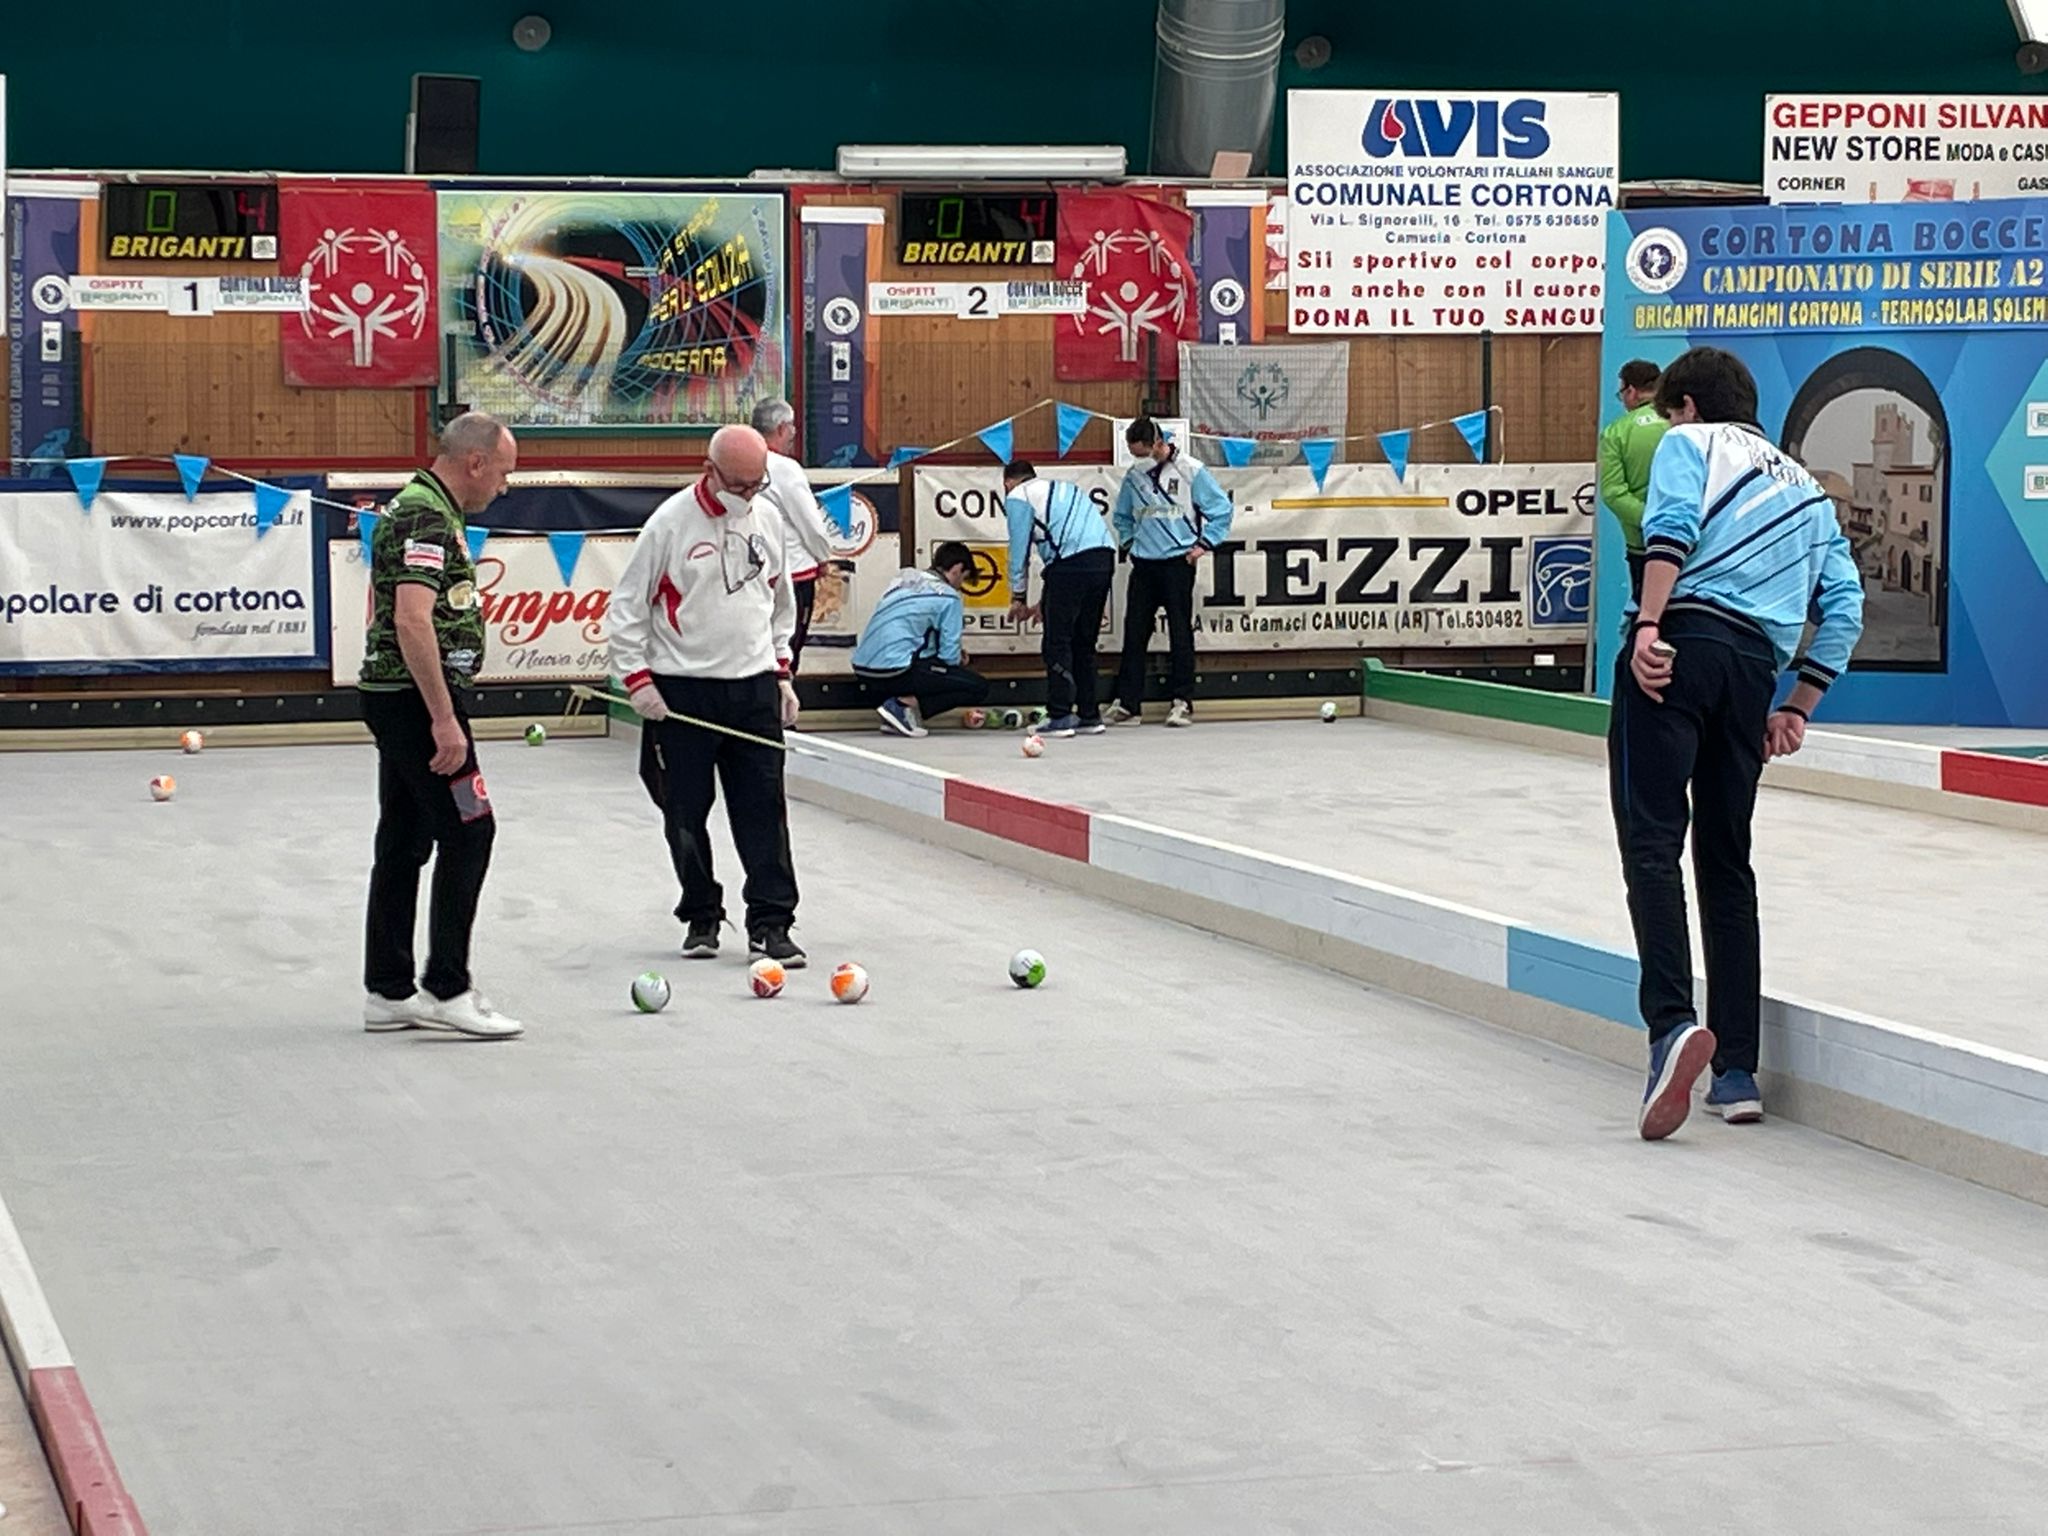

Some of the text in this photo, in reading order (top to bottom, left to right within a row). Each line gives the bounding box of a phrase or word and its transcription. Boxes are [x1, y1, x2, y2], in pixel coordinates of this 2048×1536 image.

[1773, 103, 1926, 128] GEPPONI
[1361, 98, 1551, 160] AVIS
[1772, 136, 1837, 161] NEW
[1847, 136, 1941, 161] STORE
[1947, 144, 1995, 161] MODA
[1999, 147, 2008, 161] e
[1295, 165, 1615, 178] ASSOCIAZIONE VOLONTARI ITALIANI SANGUE
[1295, 183, 1614, 207] COMUNALE CORTONA
[1778, 177, 1846, 191] CORNER
[1311, 213, 1334, 226] Via
[1475, 214, 1500, 227] Tel.
[1506, 214, 1542, 227] 0575
[111, 237, 246, 258] BRIGANTI
[1386, 231, 1451, 244] Camucia
[1465, 231, 1527, 244] Cortona
[1702, 224, 1893, 256] CORTONA
[1914, 218, 2043, 252] BOCCE
[904, 241, 1027, 264] BRIGANTI
[1353, 251, 1457, 274] sportivo
[1476, 250, 1512, 269] col
[89, 279, 144, 290] OSPITI
[1703, 258, 2044, 294] CAMPIONATO DI SERIE A2
[183, 282, 198, 311] 1
[887, 286, 936, 297] OSPITI
[968, 286, 989, 315] 2
[1295, 279, 1601, 298] ma anche con il cuore
[1294, 308, 1370, 327] DONA
[1391, 308, 1415, 327] IL
[1433, 308, 1485, 327] TUO
[1635, 304, 1709, 329] BRIGANTI
[1713, 302, 1784, 328] MANGIMI
[1788, 301, 1863, 328] CORTONA
[1881, 298, 1988, 325] TERMOSOLAR
[1456, 489, 1569, 516] OPEL
[111, 509, 304, 533] www.popcortoa.it
[1203, 537, 1523, 608] IEZZI
[0, 585, 306, 623] polare di cortona
[962, 614, 1015, 630] PEL
[1210, 614, 1234, 633] via
[1312, 611, 1389, 630] CAMUCIA
[1394, 609, 1430, 633] (AR)
